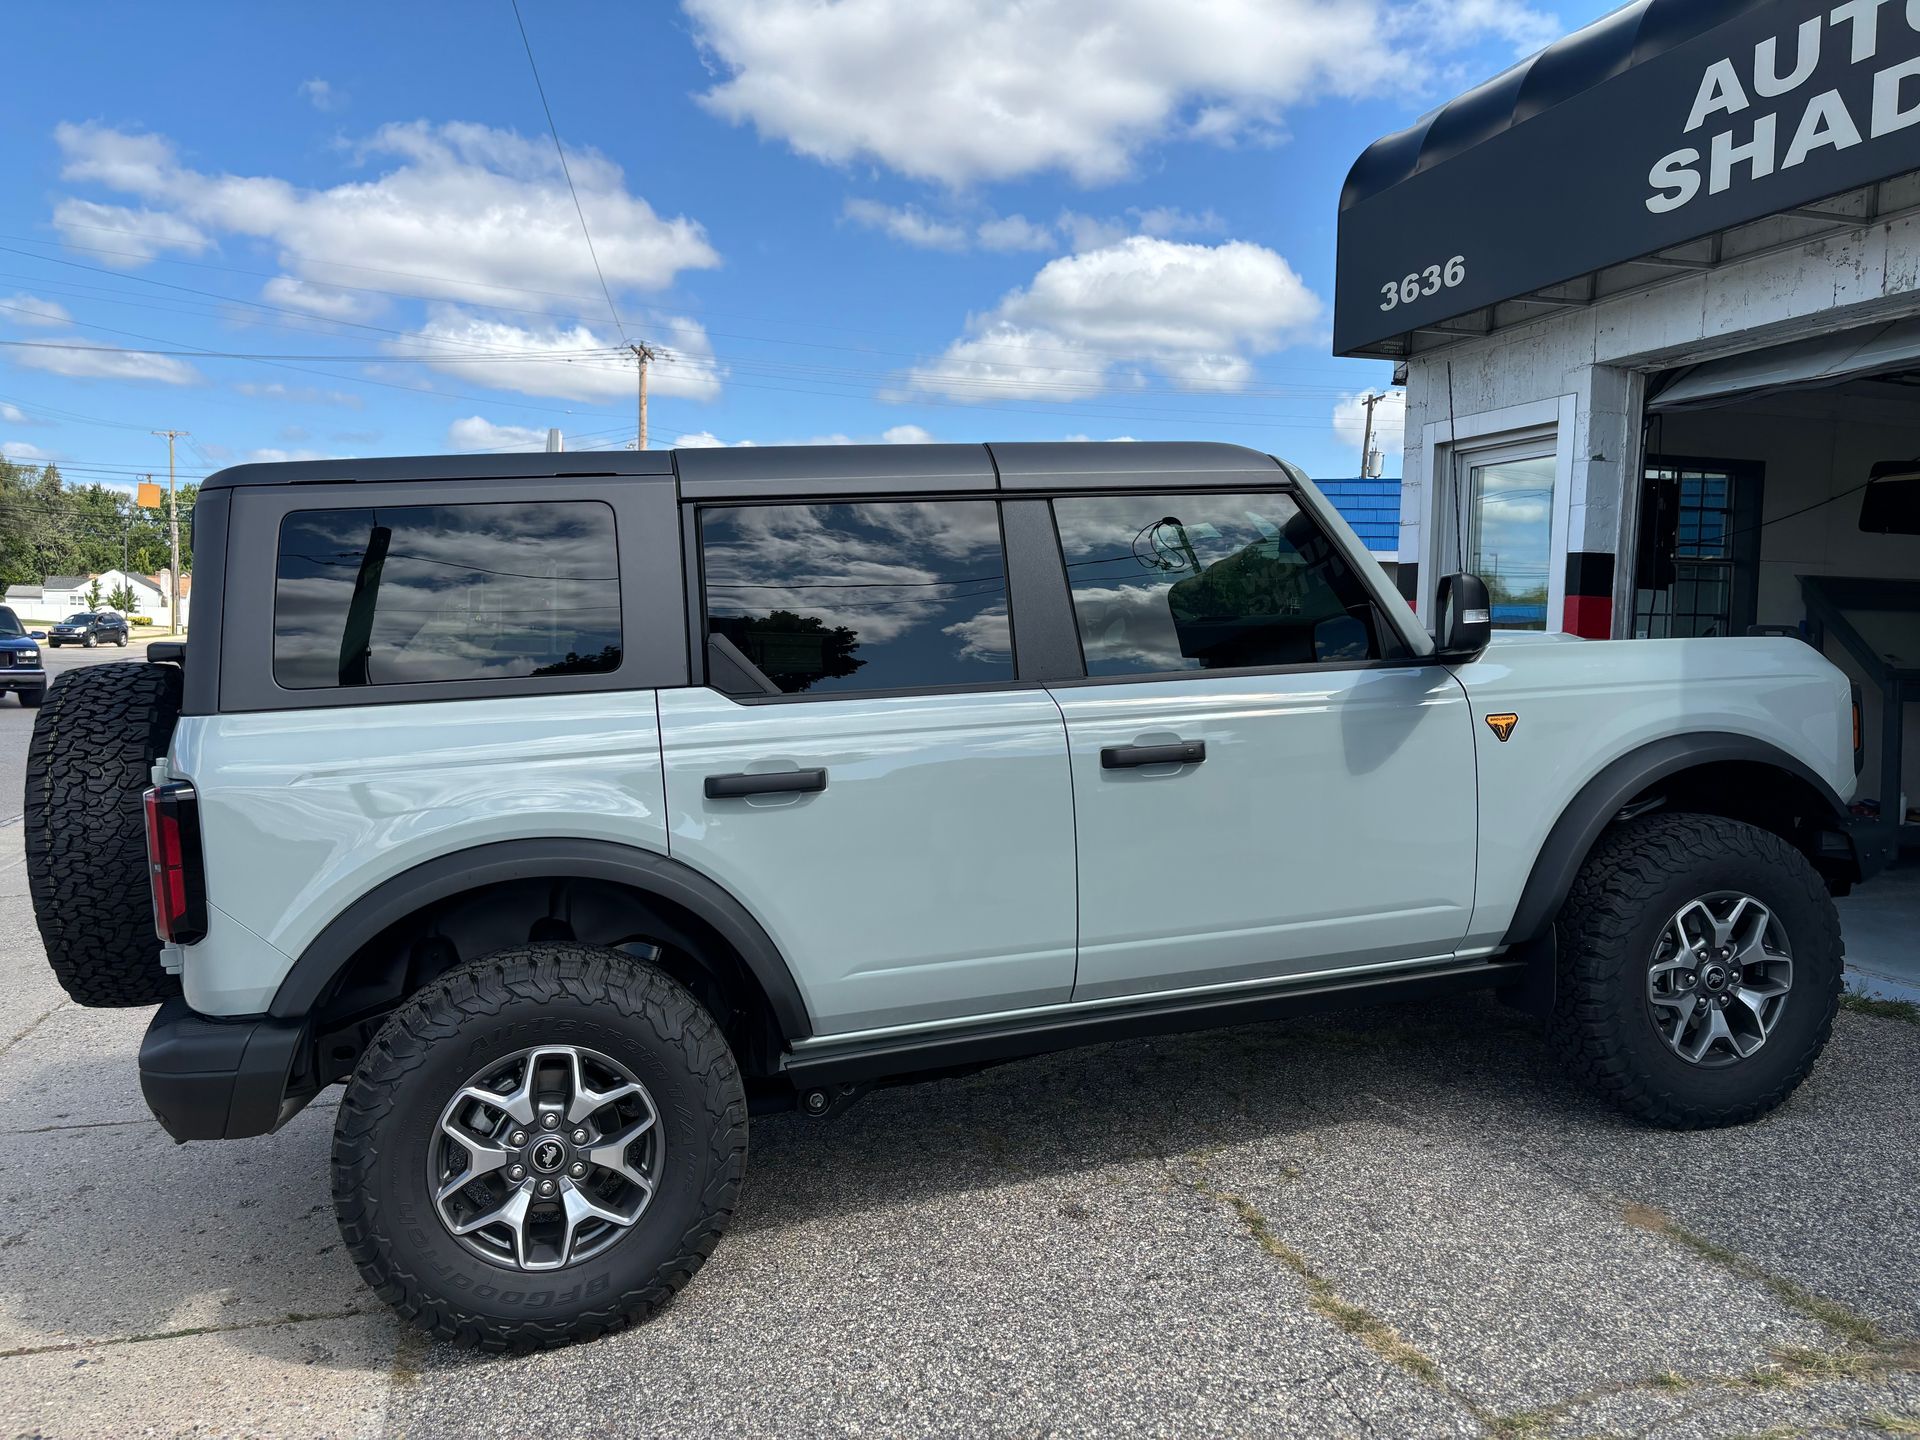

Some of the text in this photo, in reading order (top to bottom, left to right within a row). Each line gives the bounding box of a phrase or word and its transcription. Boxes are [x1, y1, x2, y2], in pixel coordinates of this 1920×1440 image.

[1683, 0, 1920, 134] AUT
[1380, 255, 1465, 311] 3636
[399, 1202, 610, 1309] BFGoodrich
